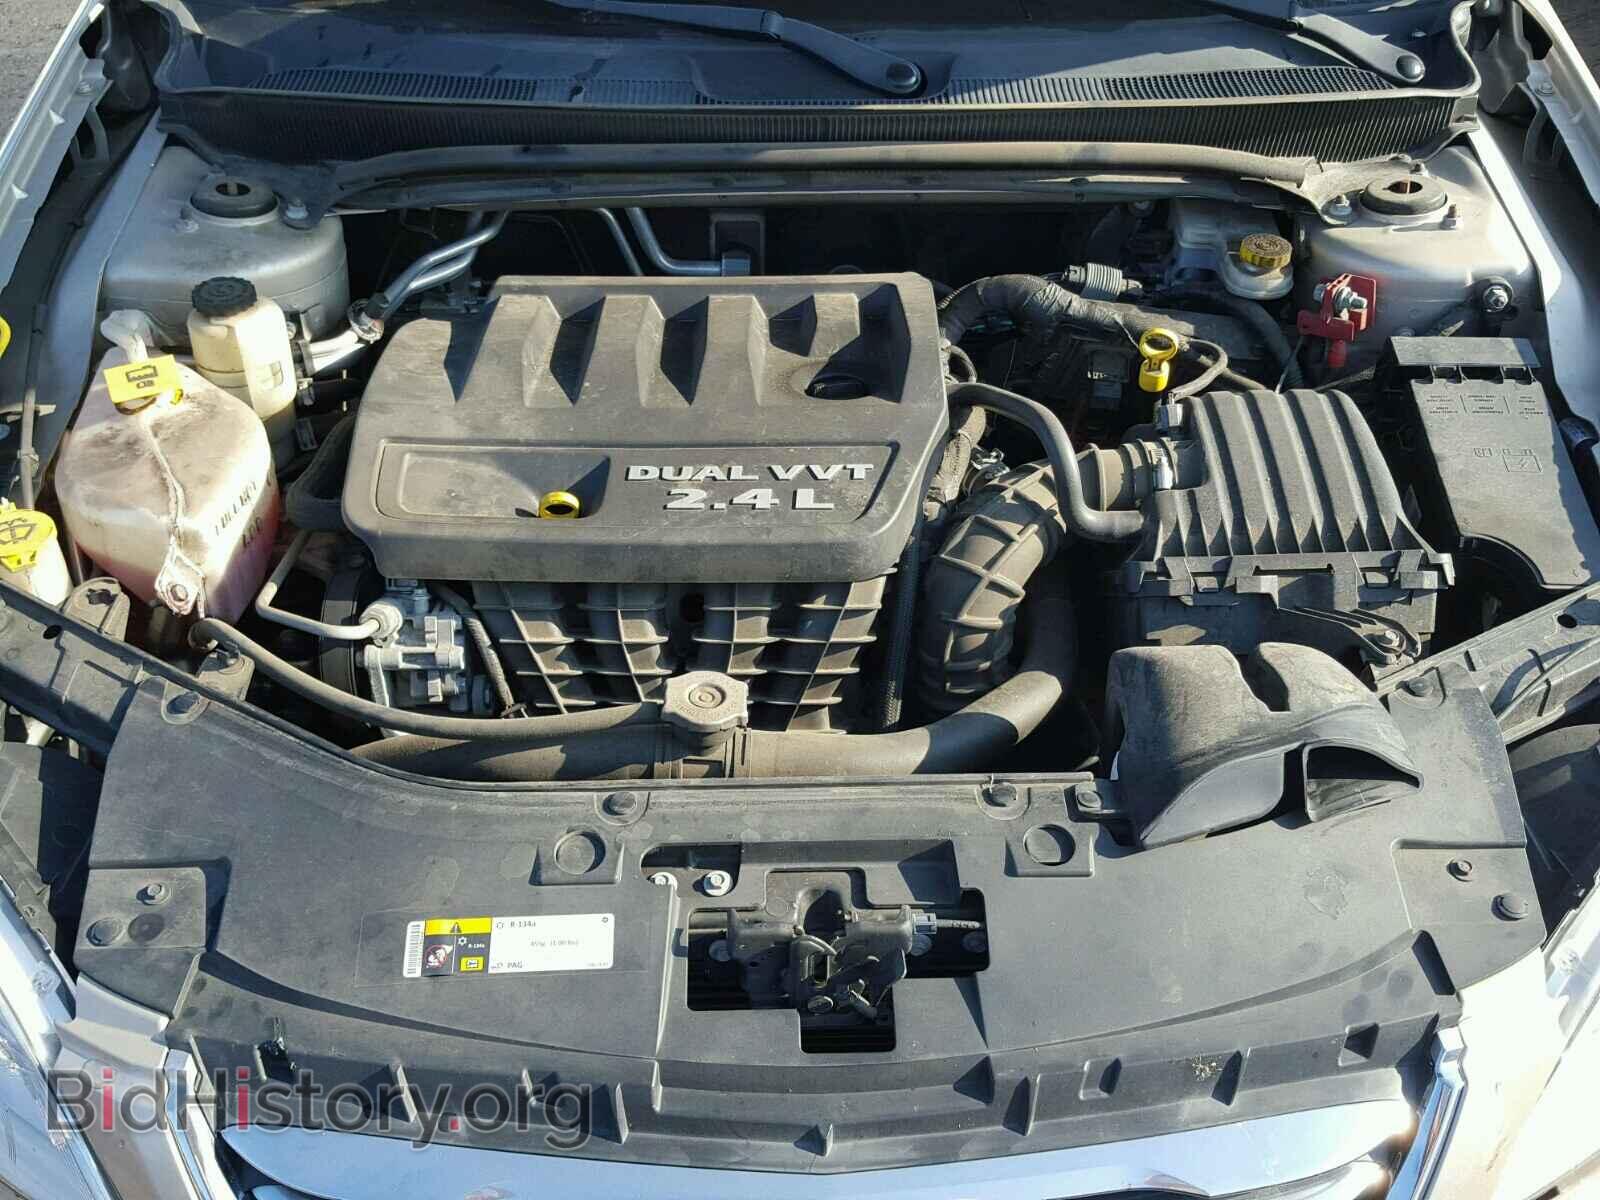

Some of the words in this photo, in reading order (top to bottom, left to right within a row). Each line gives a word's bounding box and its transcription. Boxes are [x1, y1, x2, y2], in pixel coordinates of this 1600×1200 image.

[625, 465, 760, 481] DUAL
[767, 464, 875, 481] VVT
[663, 488, 781, 510] 2.4
[792, 488, 835, 510] L
